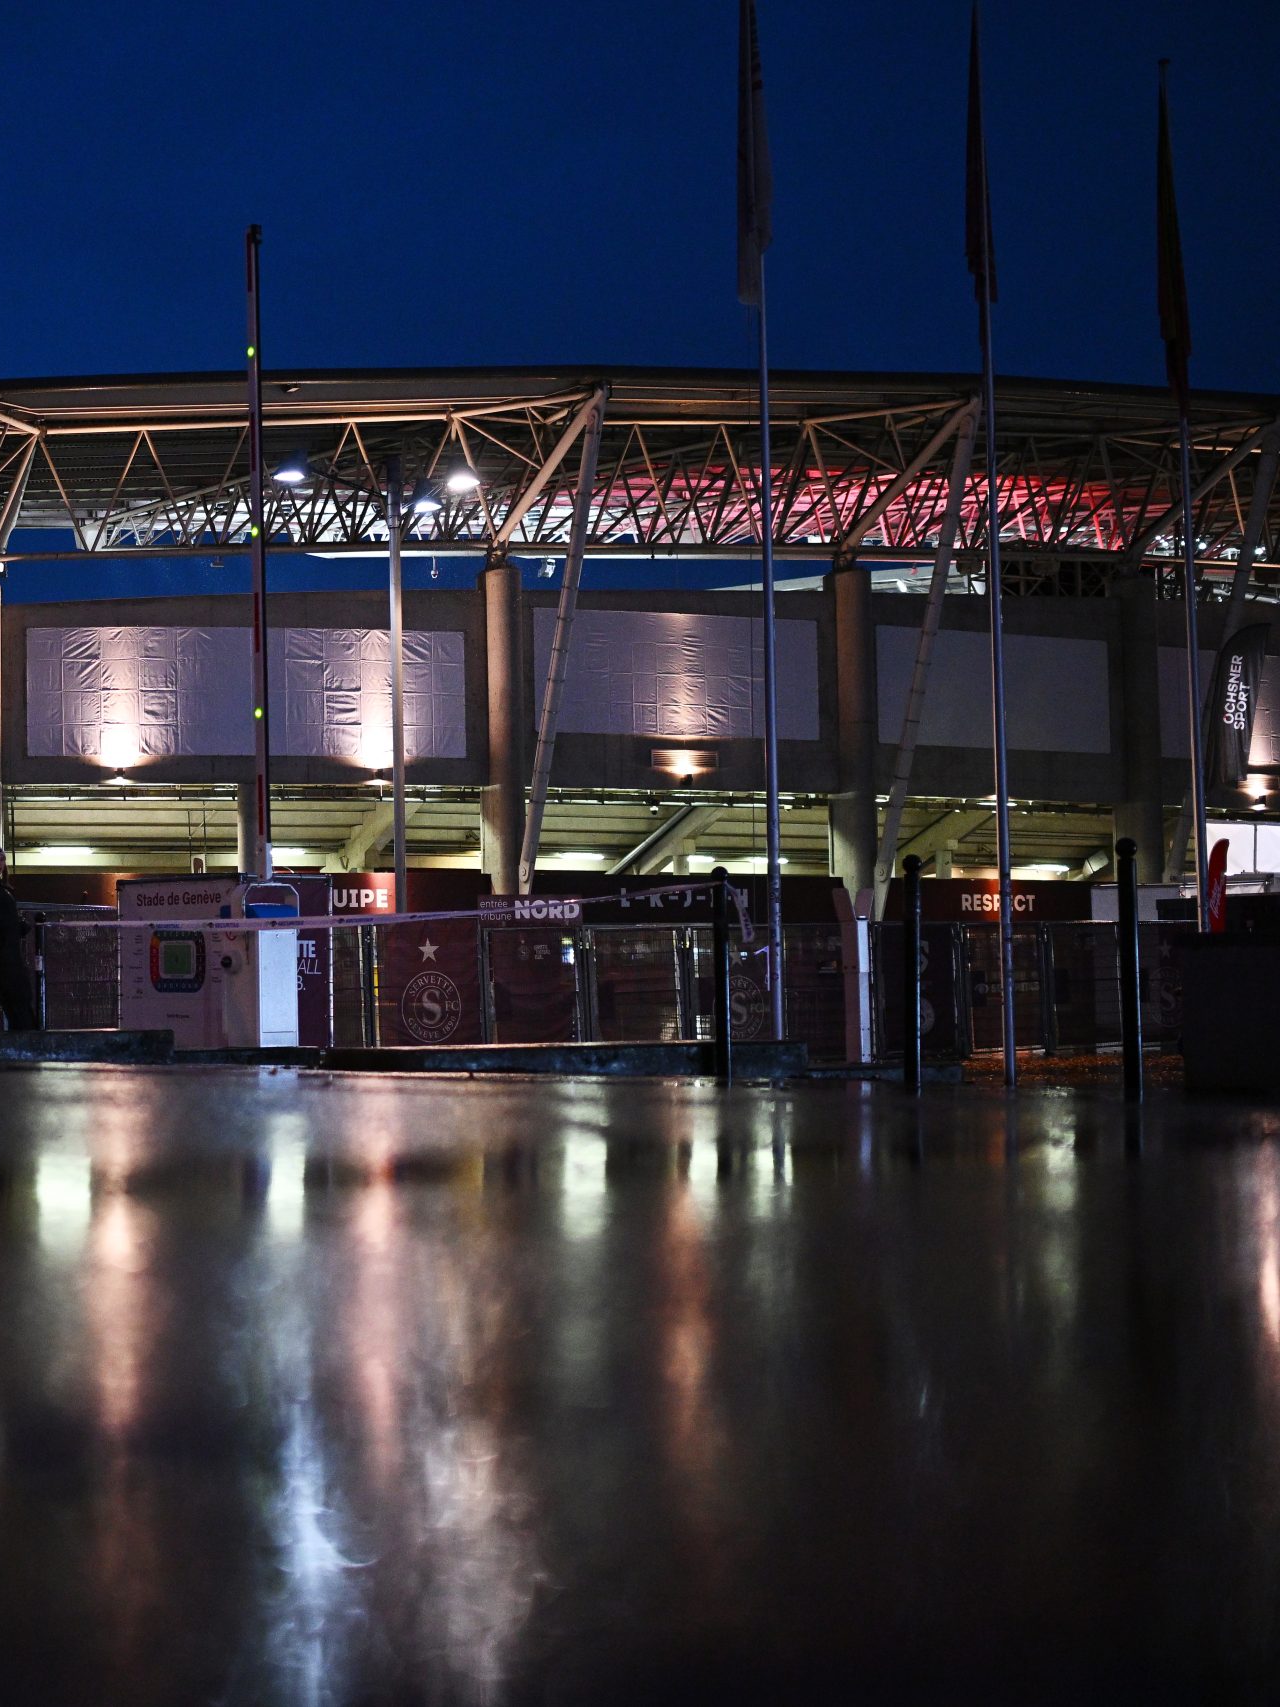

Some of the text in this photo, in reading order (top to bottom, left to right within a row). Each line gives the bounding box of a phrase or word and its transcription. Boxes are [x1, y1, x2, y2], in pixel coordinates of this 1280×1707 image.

[1223, 654, 1244, 724] OCHSNER
[1233, 681, 1250, 730] SPORT
[136, 890, 221, 907] Stade de Genève
[333, 889, 388, 908] UIPE
[480, 899, 508, 908] entrée
[961, 894, 1036, 912] RESPCT
[480, 911, 512, 920] tribune
[514, 900, 580, 919] NORD
[408, 975, 454, 997] SERVETTE
[422, 990, 442, 1025] S
[445, 1000, 460, 1012] FC
